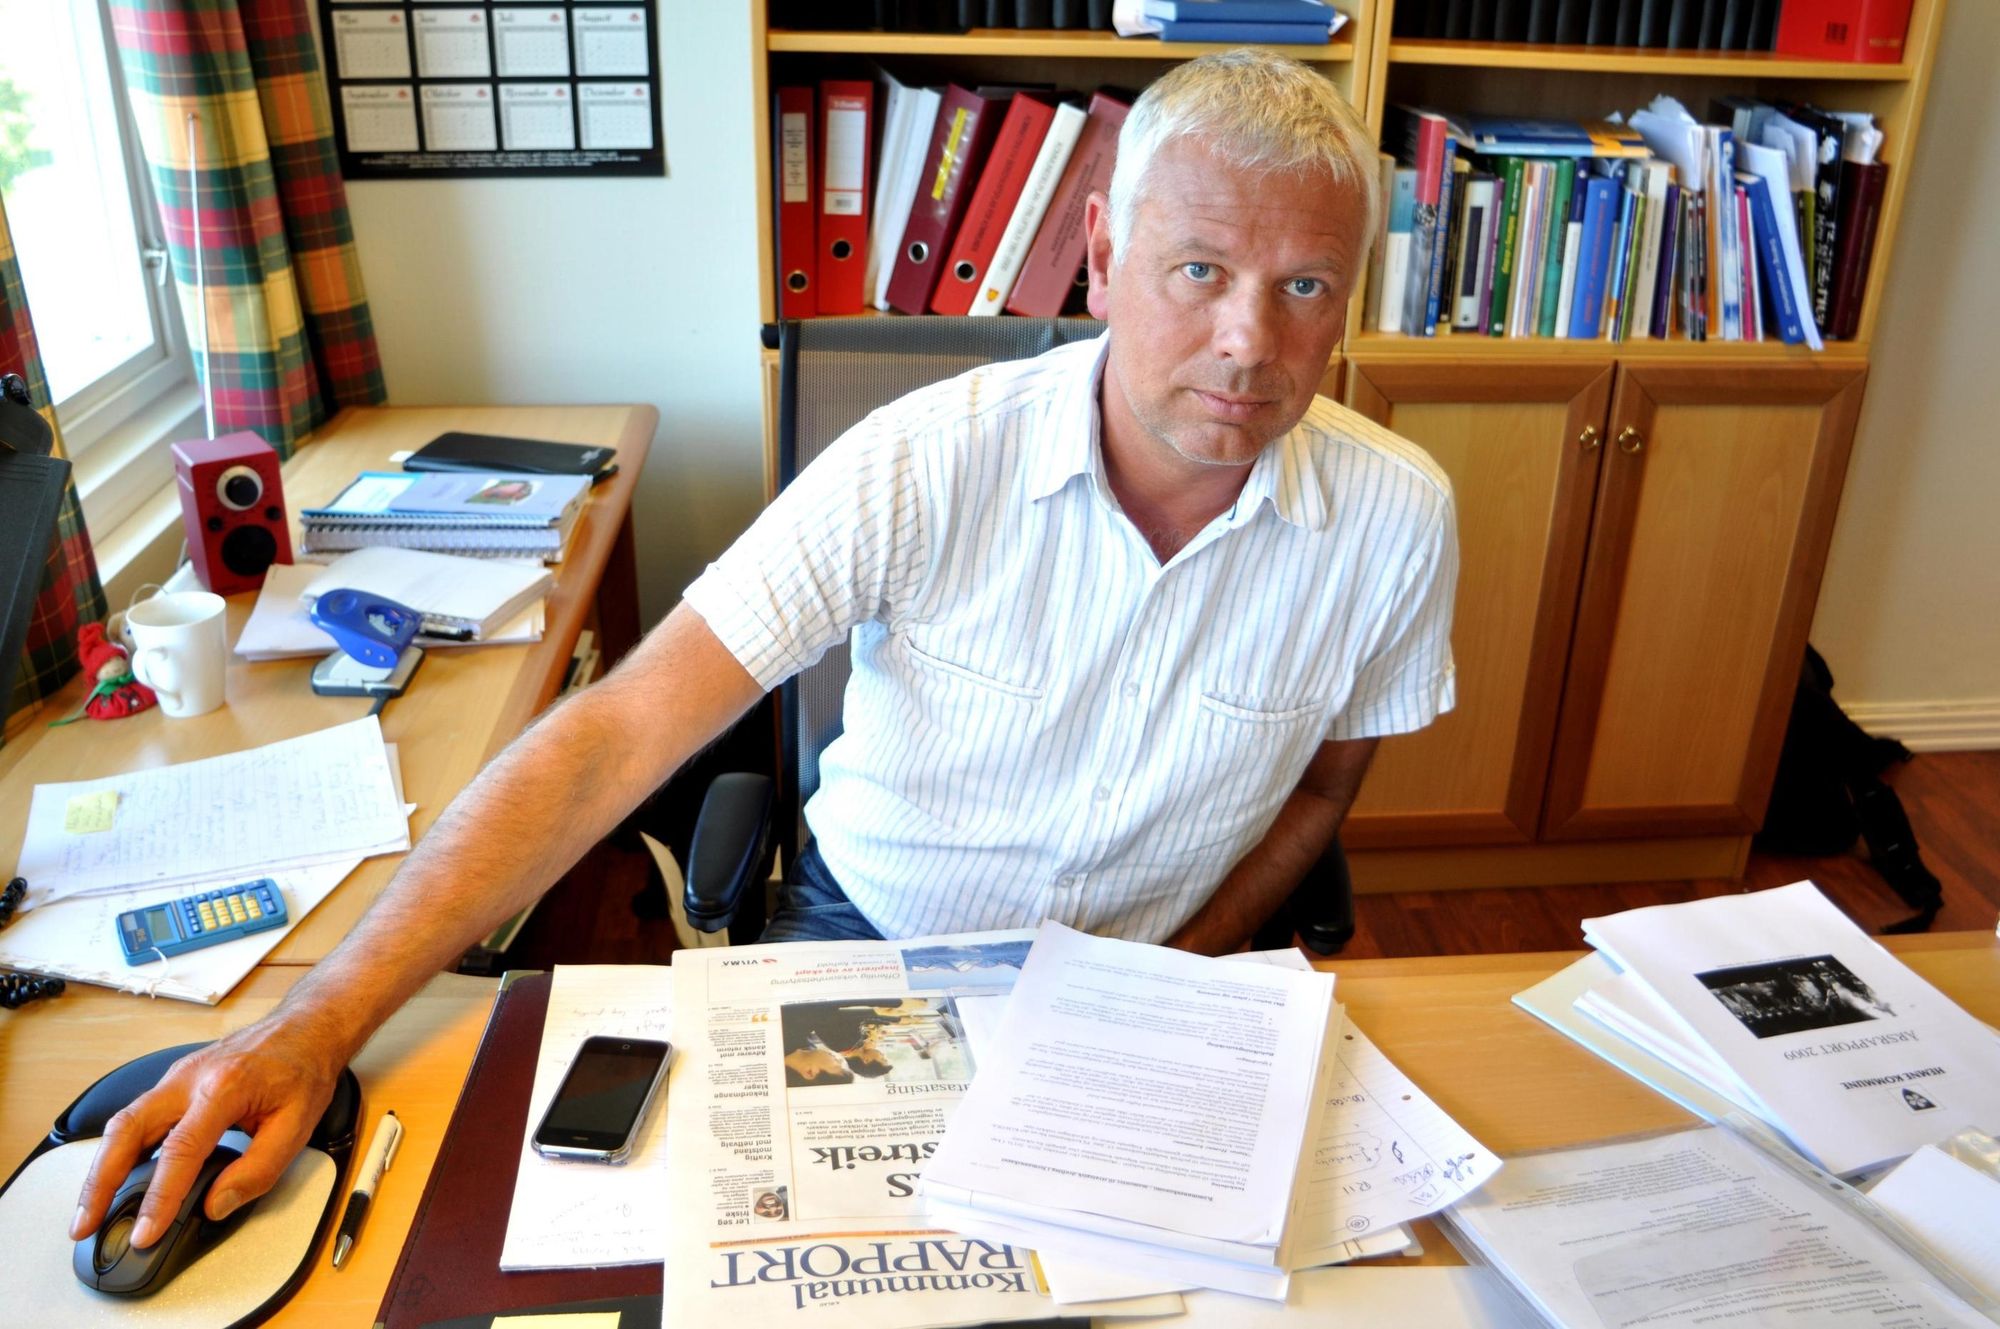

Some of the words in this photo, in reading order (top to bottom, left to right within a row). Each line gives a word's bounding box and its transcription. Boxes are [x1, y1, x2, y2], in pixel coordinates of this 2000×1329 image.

[795, 968, 823, 976] skapt
[856, 964, 899, 972] inspirert
[770, 973, 858, 986] virksomhetsstyring
[860, 972, 900, 980] Offentlig
[1819, 1030, 1918, 1056] ÅRSRAPPORT
[1783, 1046, 1817, 1061] 2009
[1900, 1066, 1946, 1080] HEMNE
[1840, 1074, 1903, 1090] KOMMUNE
[714, 1090, 769, 1099] Rekordmange
[721, 1140, 753, 1148] nettvalg
[734, 1146, 772, 1155] motstand
[809, 1142, 939, 1171] streik
[886, 1172, 924, 1198] S
[725, 1210, 750, 1218] friske
[717, 1218, 733, 1226] seg
[710, 1239, 1024, 1288] RAPPORT
[792, 1272, 1030, 1309] Kommunal
